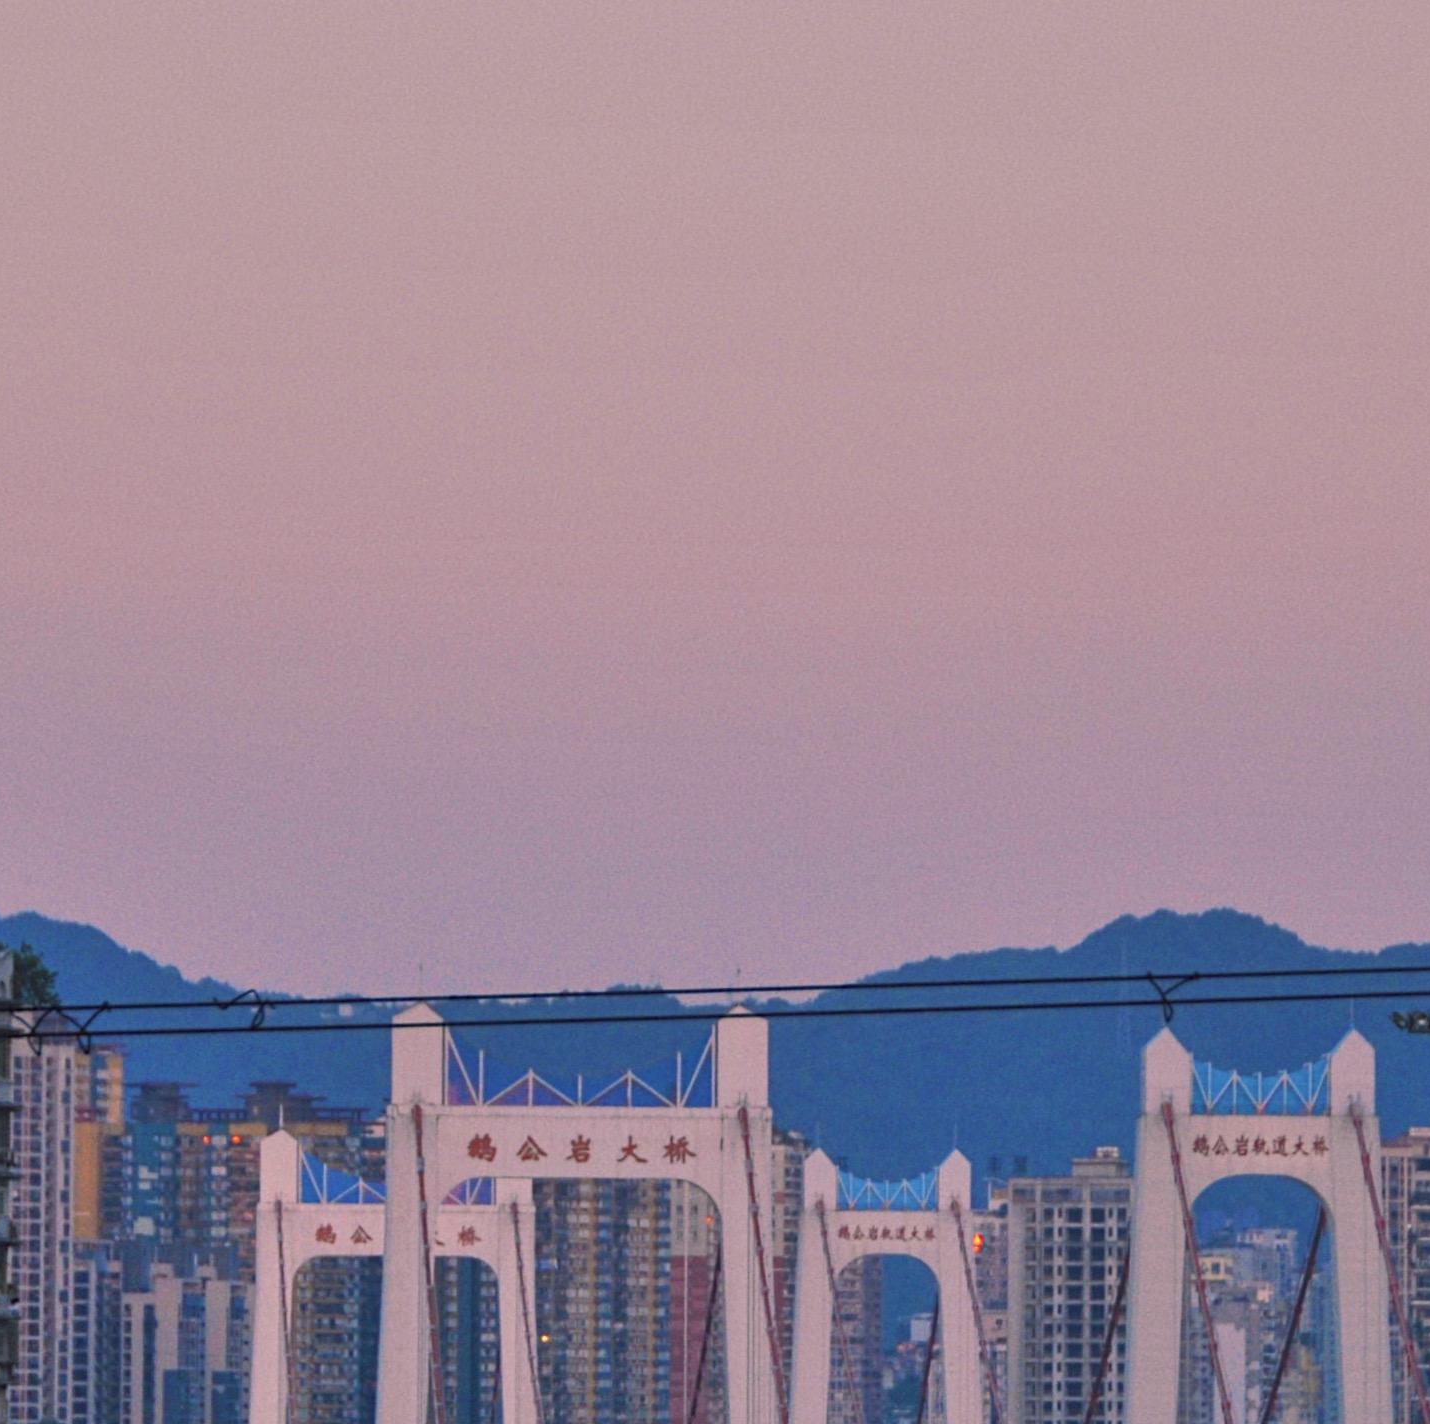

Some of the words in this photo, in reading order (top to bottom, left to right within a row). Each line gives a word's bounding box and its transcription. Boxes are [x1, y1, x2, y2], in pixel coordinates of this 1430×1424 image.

[467, 1133, 697, 1164] 鹅公岩大桥
[1193, 1134, 1330, 1157] 鹅公岩轨道大桥
[315, 1223, 482, 1246] 鹅公桥
